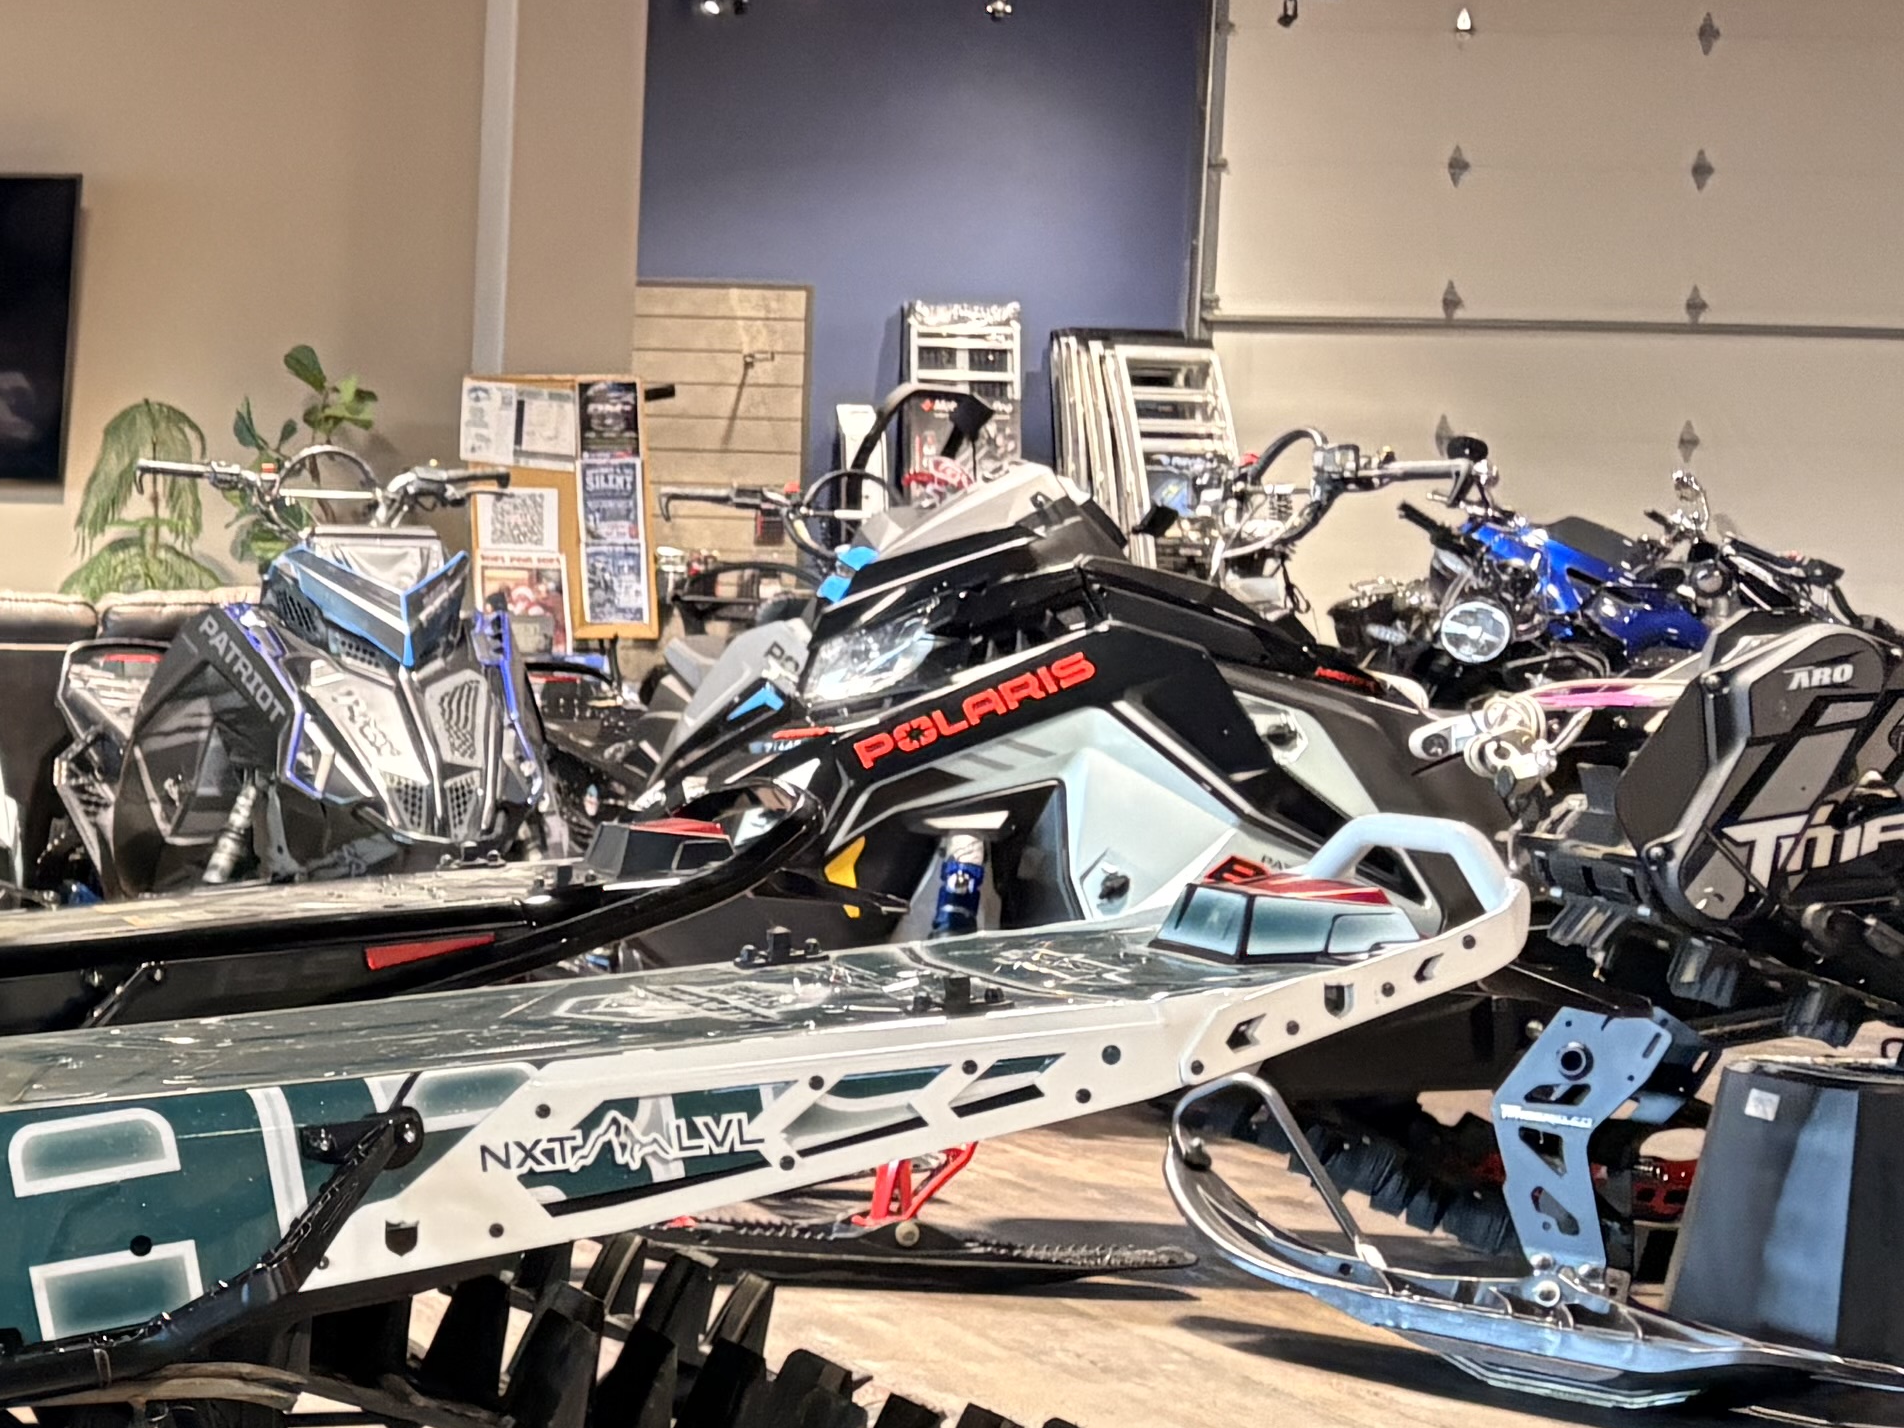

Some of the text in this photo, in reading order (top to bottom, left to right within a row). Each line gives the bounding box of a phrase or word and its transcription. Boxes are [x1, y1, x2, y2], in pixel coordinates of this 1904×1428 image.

[198, 614, 286, 722] PATRIOT
[1783, 663, 1854, 691] ARO
[853, 651, 1096, 770] POLARIS
[480, 1117, 765, 1173] NXT LVL
